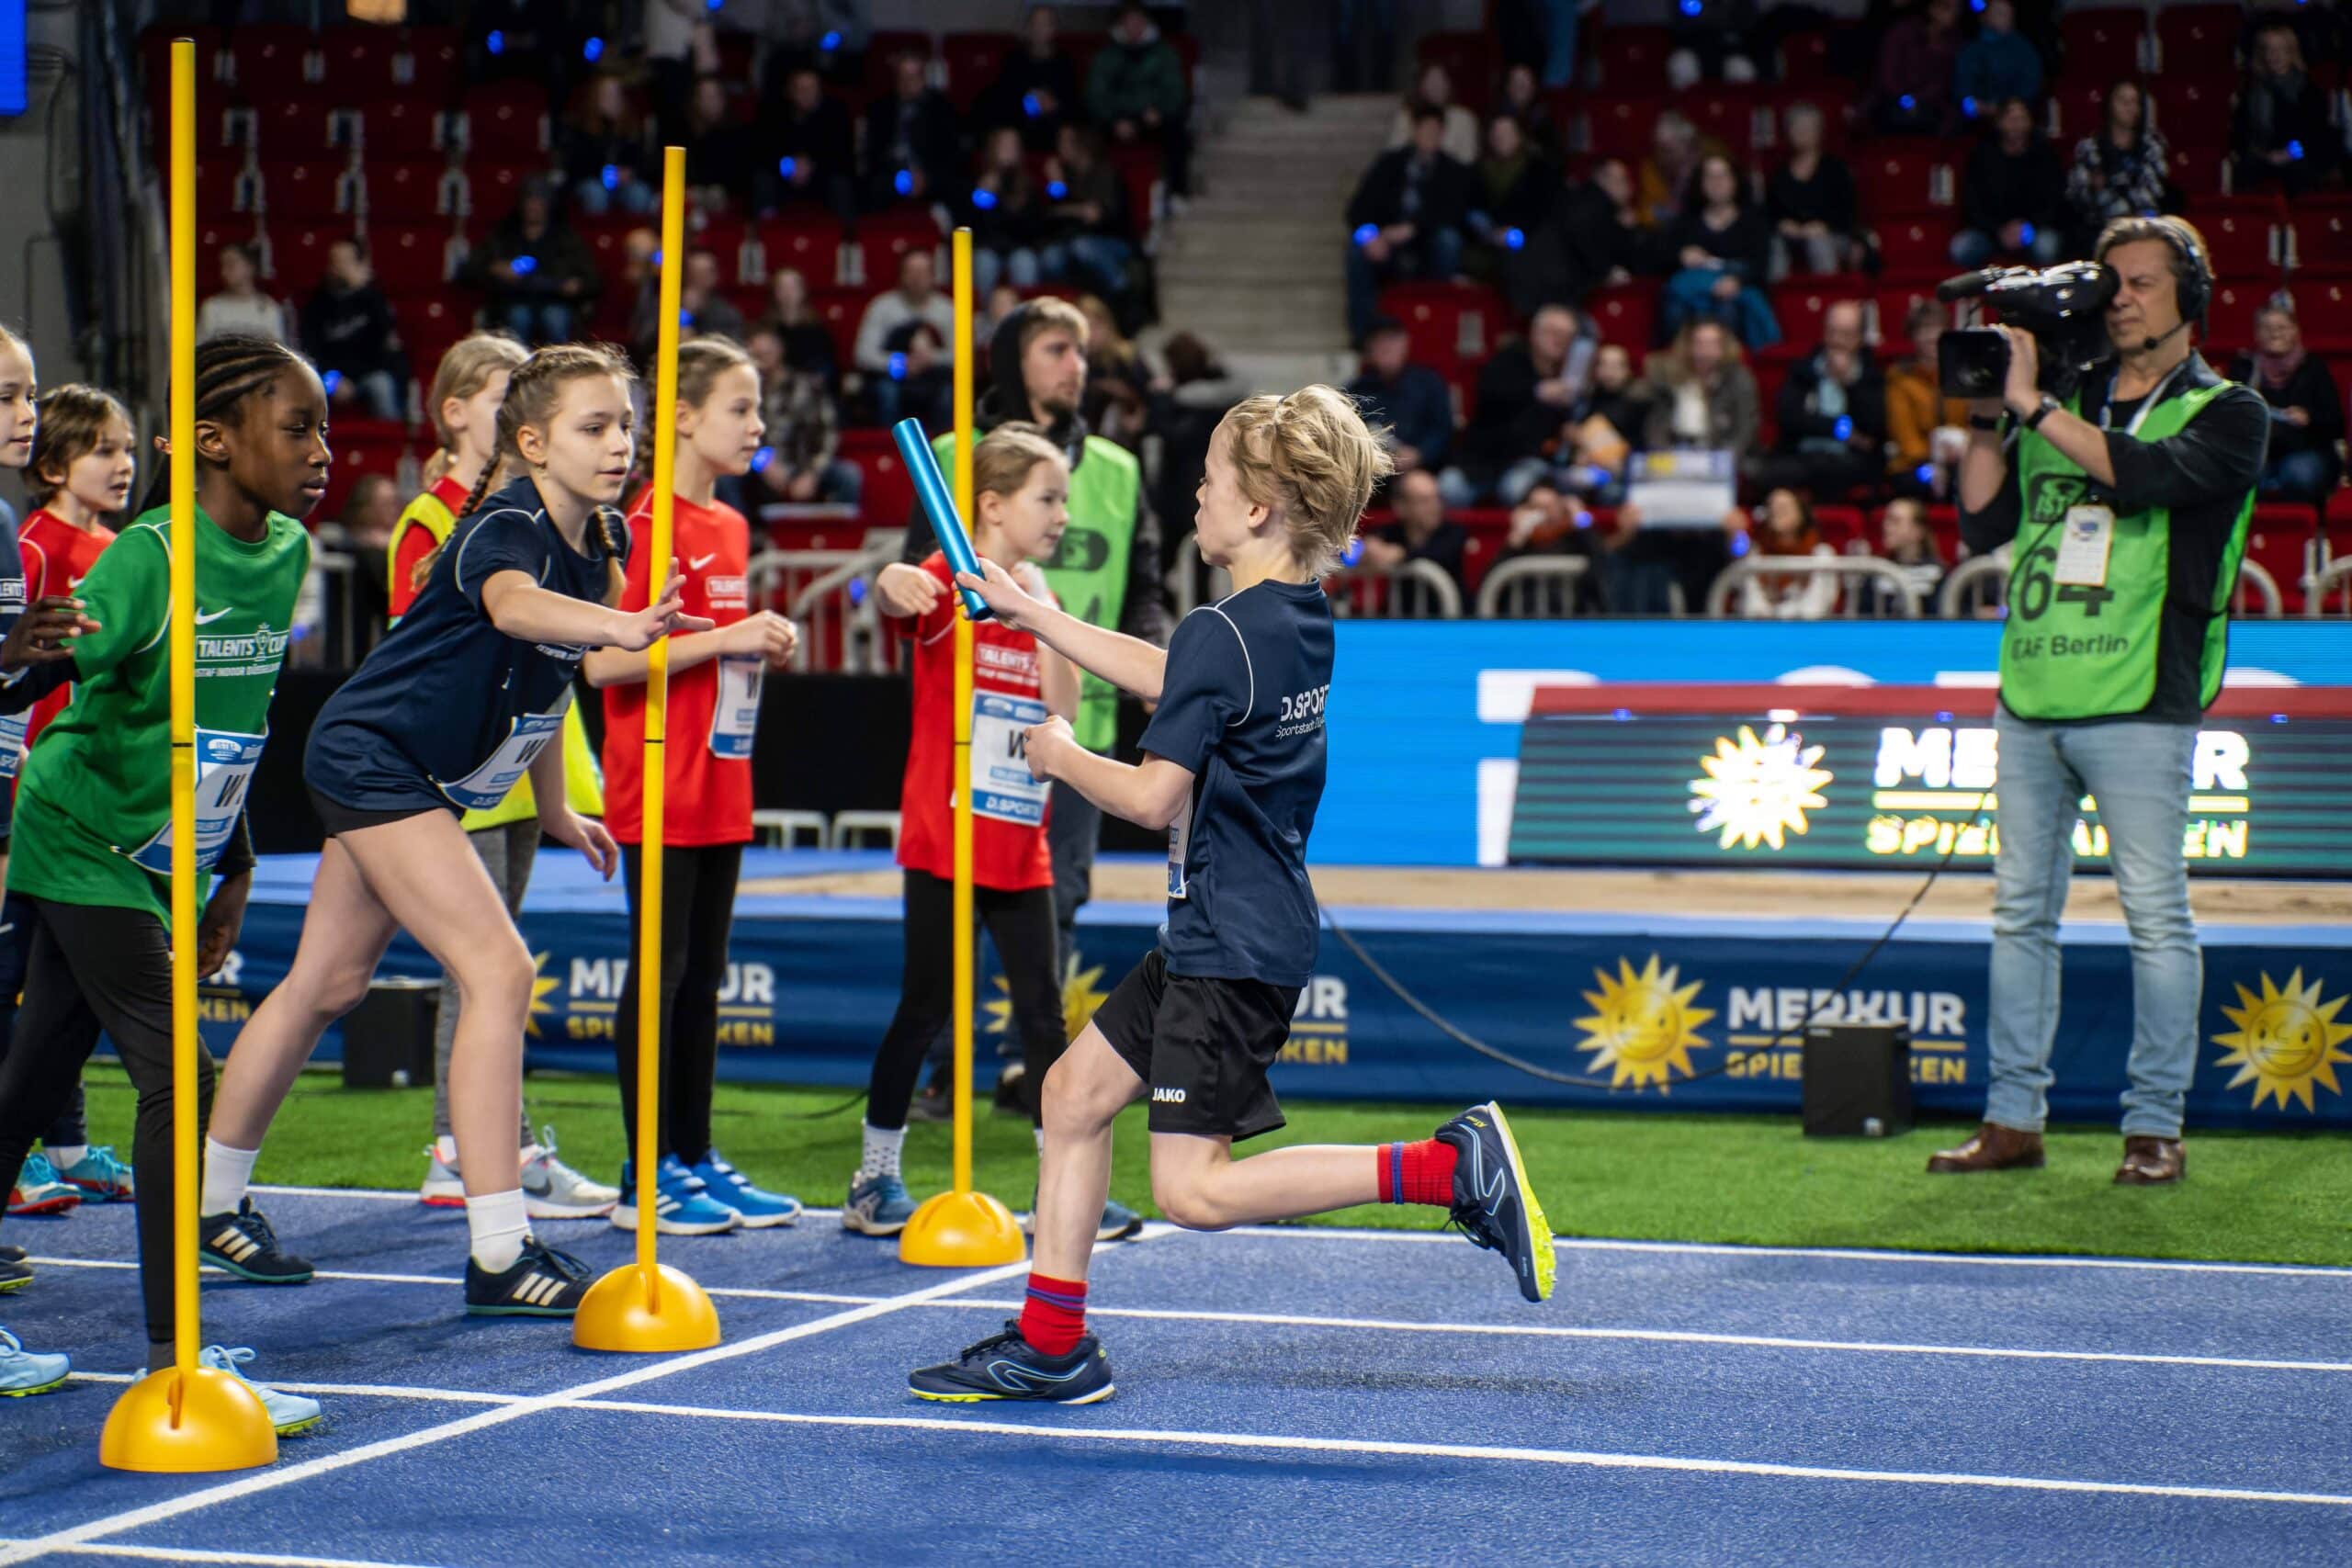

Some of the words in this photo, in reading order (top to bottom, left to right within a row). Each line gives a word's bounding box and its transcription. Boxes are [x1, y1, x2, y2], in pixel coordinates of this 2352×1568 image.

[198, 639, 255, 658] TALENTS
[2052, 634, 2129, 656] Berlin
[978, 647, 1030, 670] TALENTS
[1152, 1088, 1186, 1102] JAKO
